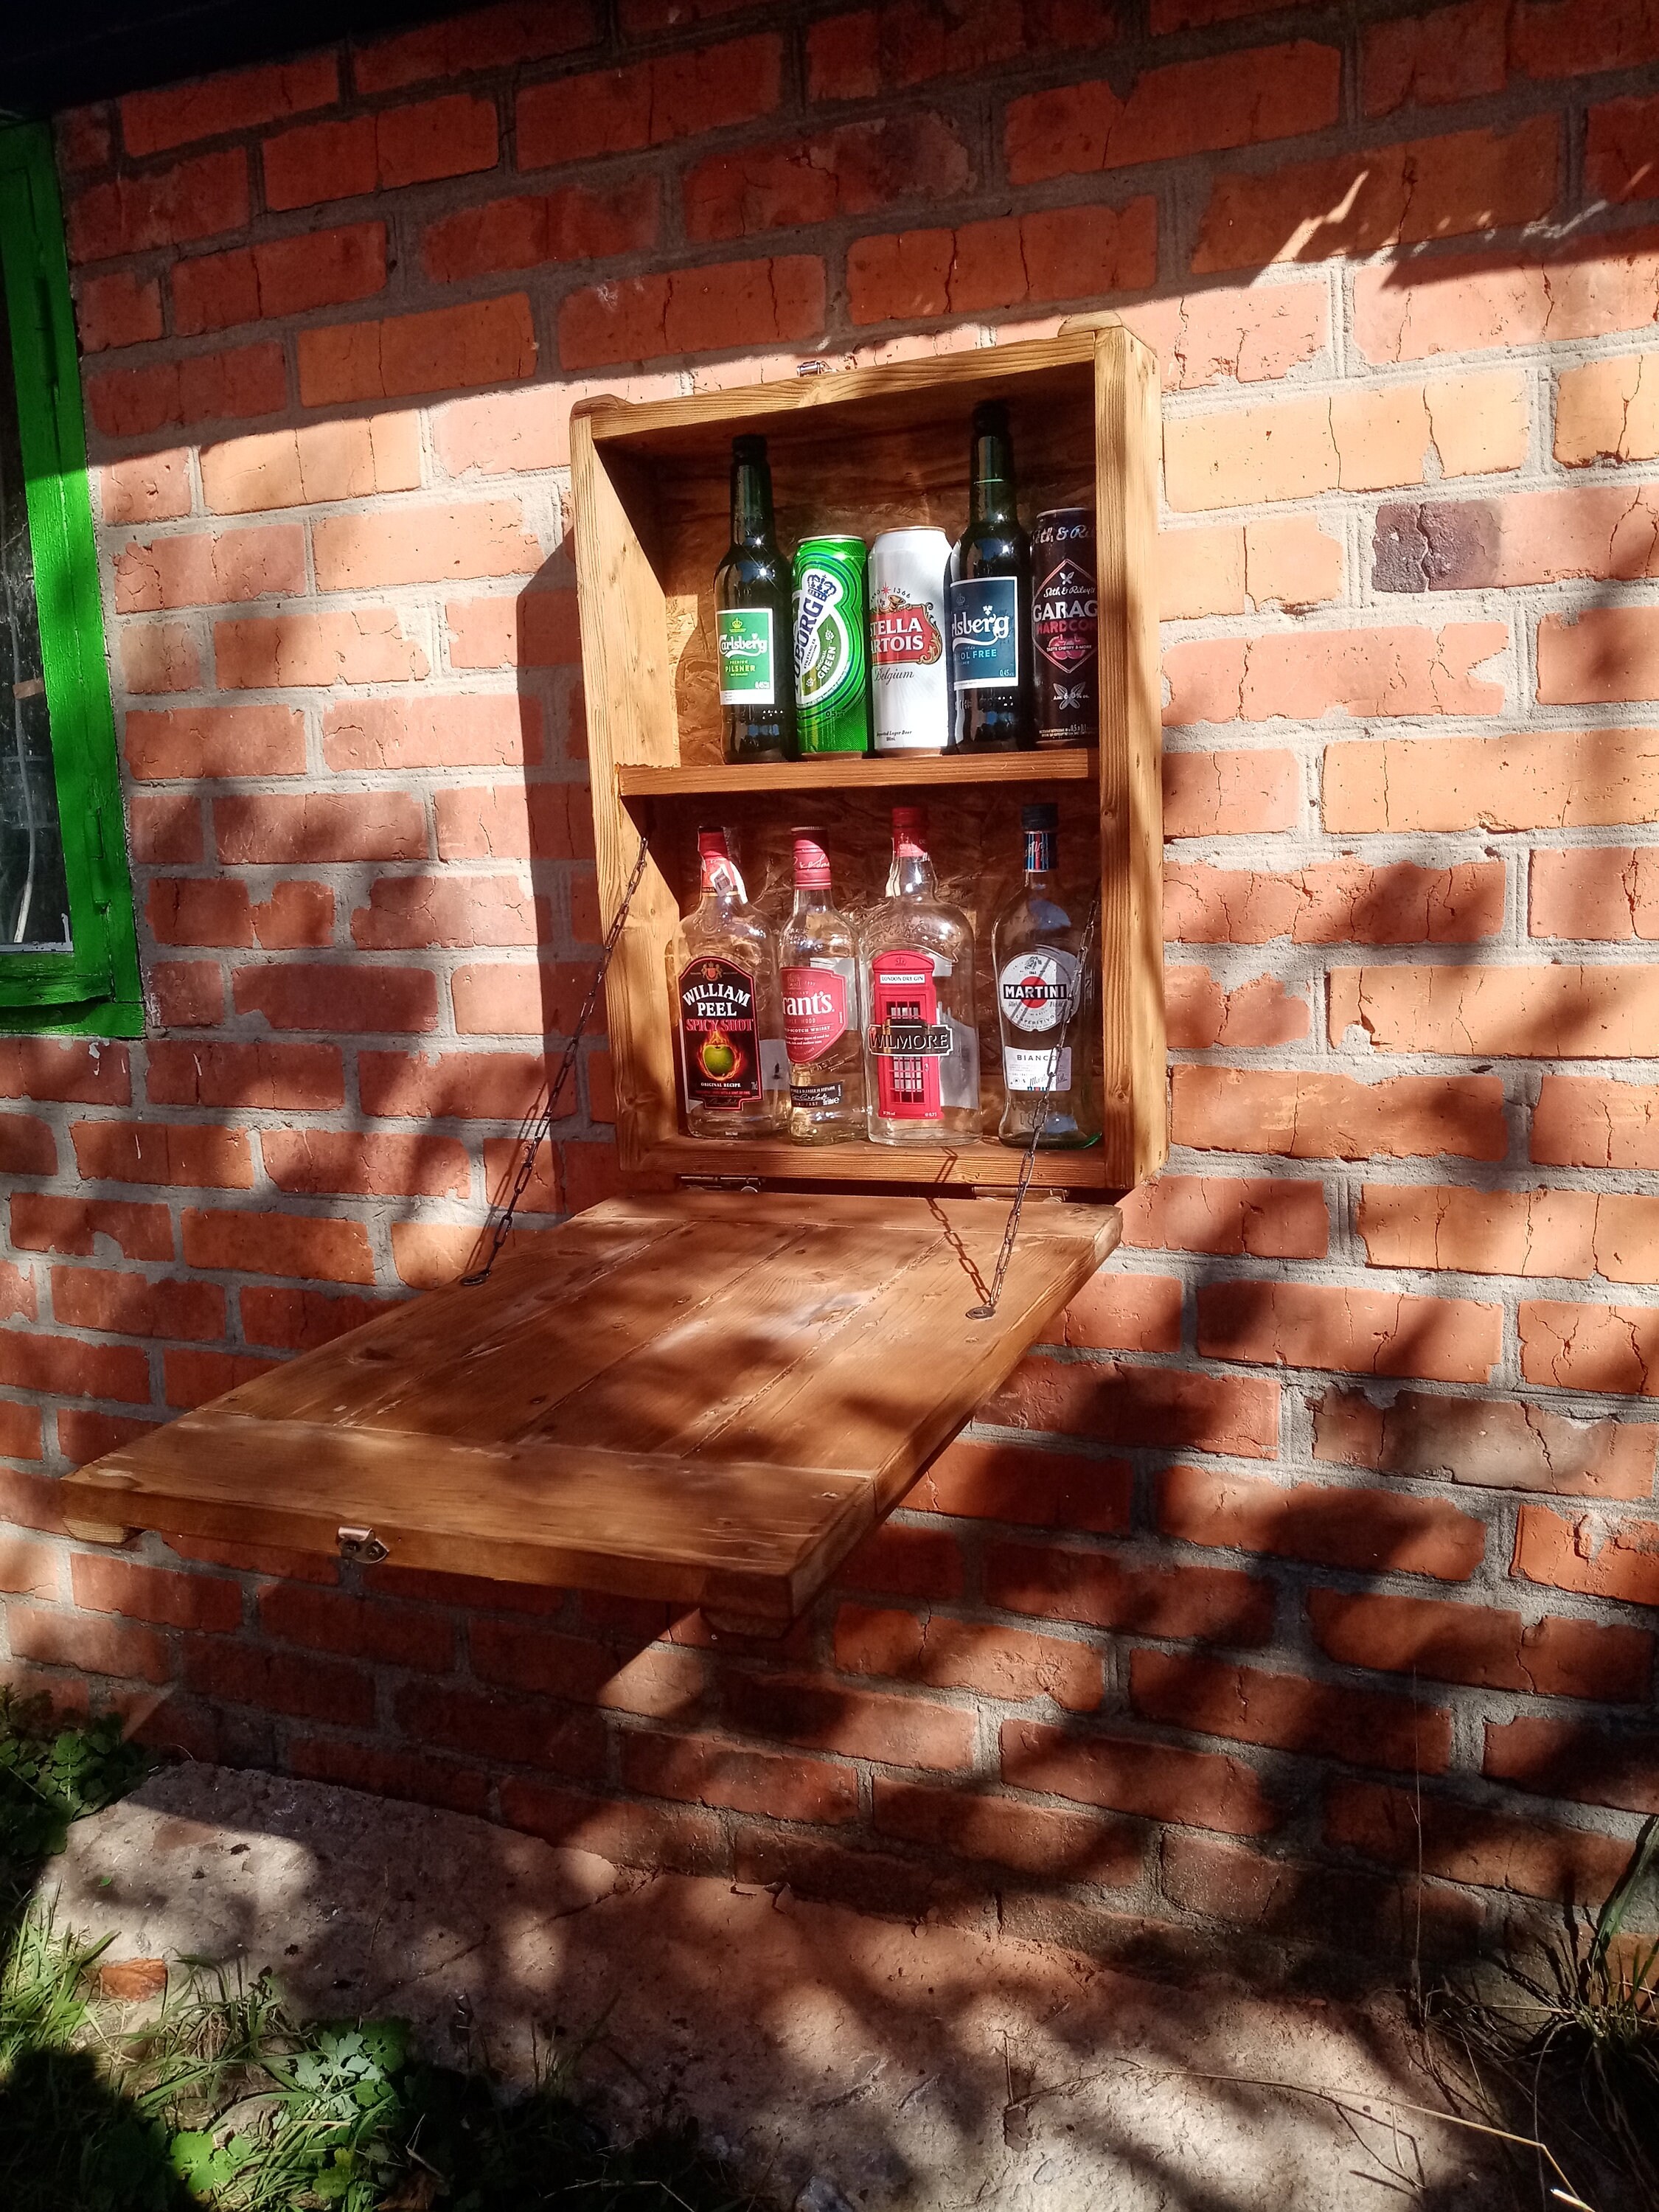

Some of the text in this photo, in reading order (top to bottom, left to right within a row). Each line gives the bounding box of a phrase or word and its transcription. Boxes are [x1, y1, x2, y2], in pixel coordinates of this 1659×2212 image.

[1056, 526, 1069, 541] &
[893, 588, 911, 598] 1366
[1061, 587, 1069, 595] &
[1037, 620, 1067, 635] HARD
[719, 633, 768, 658] Carlsberg
[973, 649, 997, 658] FREE
[726, 664, 756, 672] PILSNER
[817, 646, 836, 679] GREEN
[874, 667, 914, 685] Belgium
[682, 984, 751, 1007] WILLIAM
[1005, 986, 1065, 998] MARTINI
[697, 1003, 737, 1016] PEEL
[686, 1019, 752, 1032] SPICY SHOT
[870, 1034, 949, 1050] WILMORE
